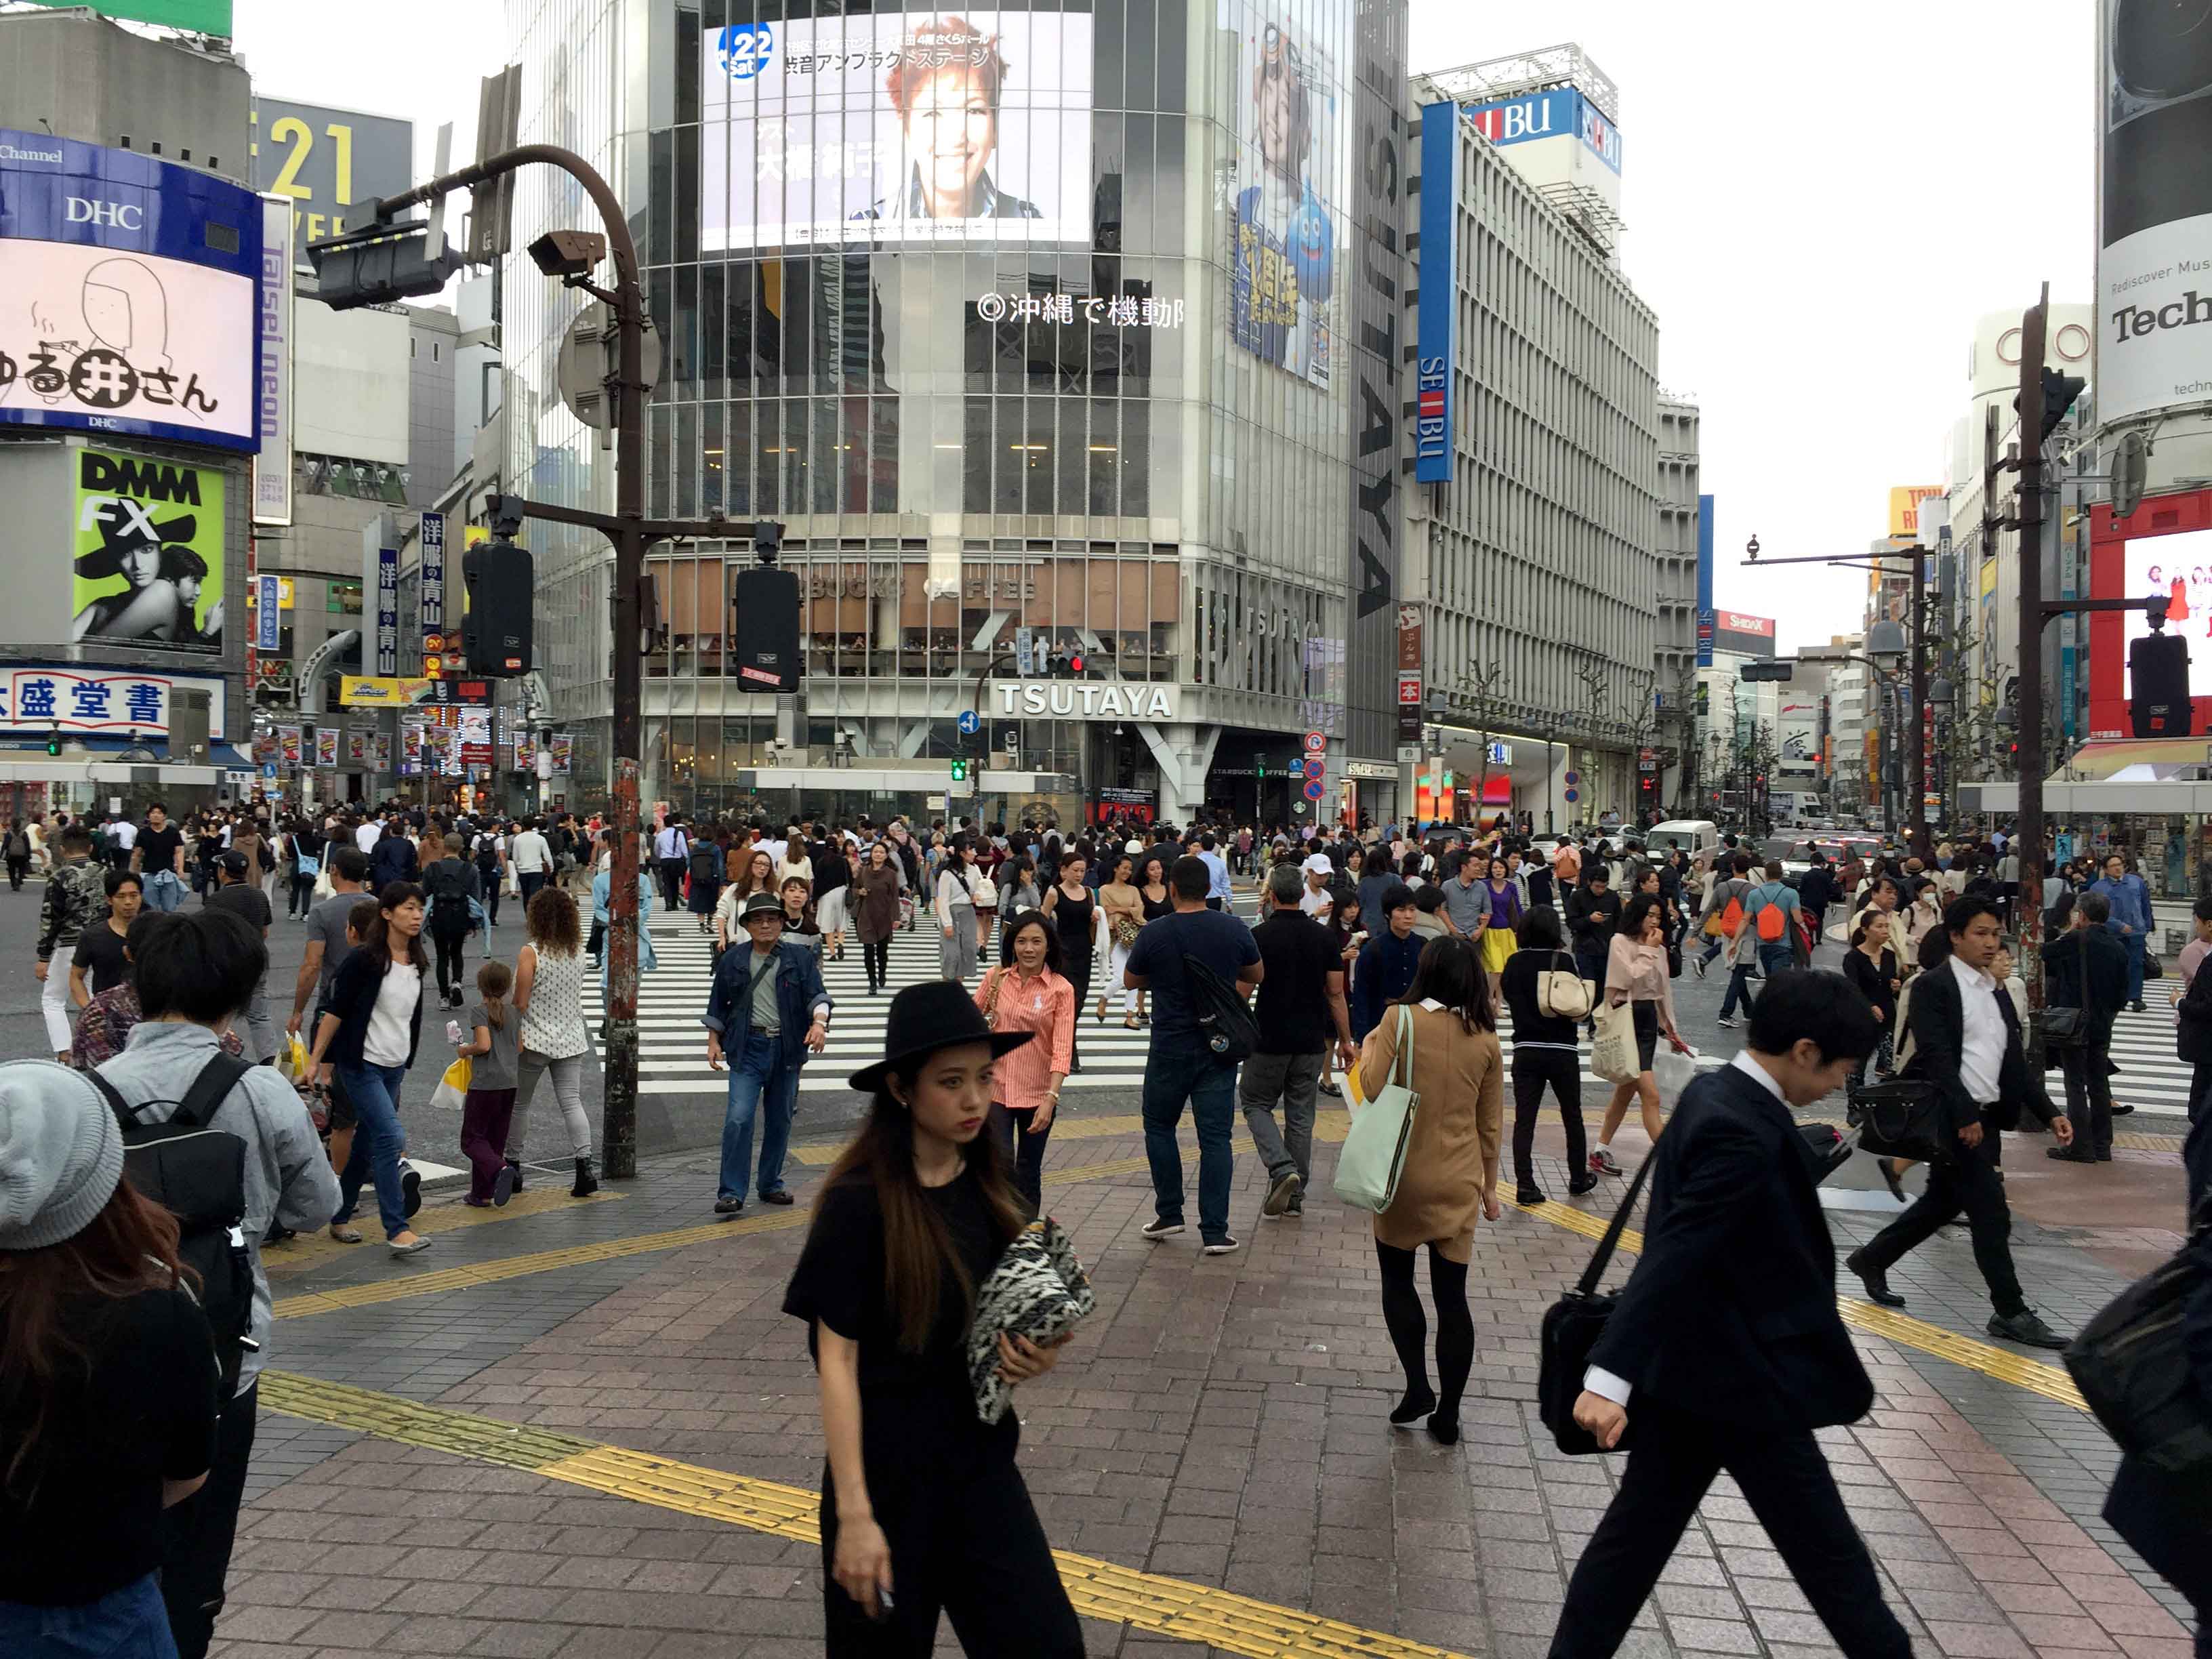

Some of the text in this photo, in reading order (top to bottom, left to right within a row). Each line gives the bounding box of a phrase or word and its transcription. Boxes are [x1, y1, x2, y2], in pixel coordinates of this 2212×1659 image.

[1468, 98, 1552, 140] IBU
[1582, 105, 1620, 169] SEIBU
[0, 145, 63, 163] Channel
[65, 197, 142, 230] DHC
[2111, 267, 2175, 296] Rediscover
[261, 352, 279, 437] neon
[1420, 356, 1445, 457] SEIBU
[89, 416, 117, 429] DHC
[81, 451, 201, 507] DMM
[79, 495, 161, 542] FX
[422, 519, 443, 625] 洋服の青山
[379, 562, 396, 674] 洋服の青山
[1698, 610, 1713, 656] SEIBU
[0, 678, 163, 722] 盛堂書
[998, 684, 1172, 716] TSUTAYA
[1401, 682, 1418, 700] 本
